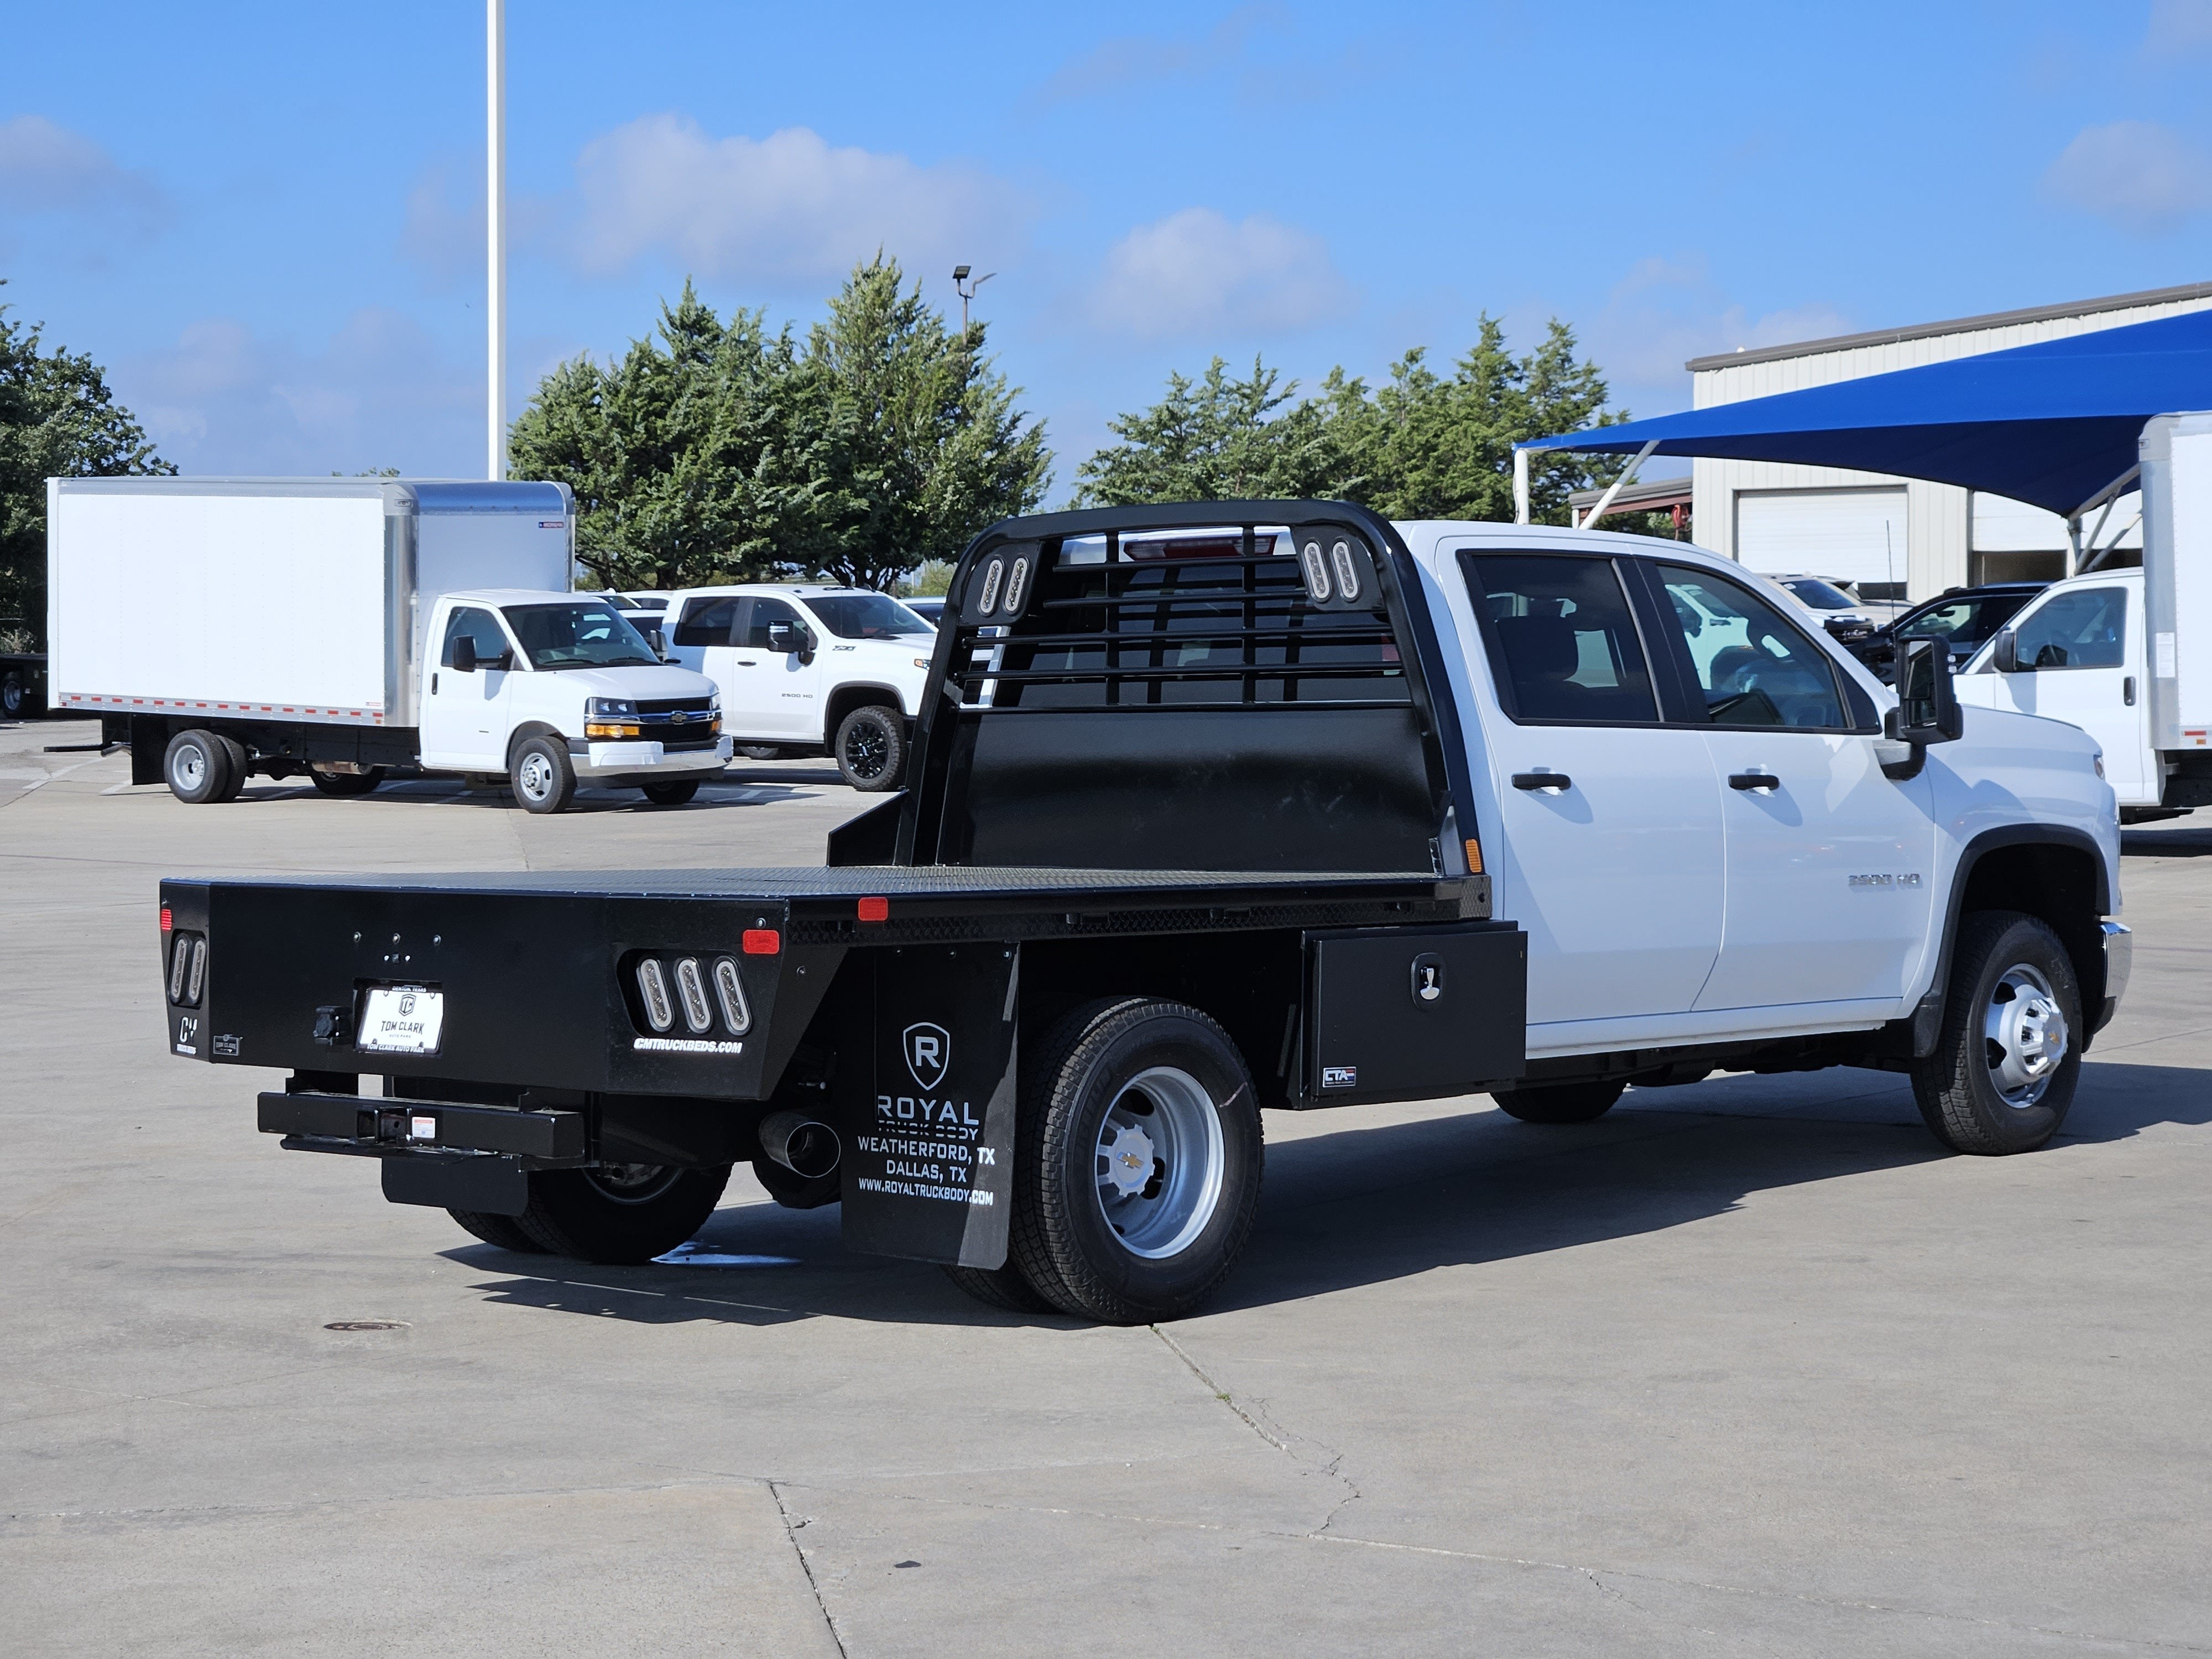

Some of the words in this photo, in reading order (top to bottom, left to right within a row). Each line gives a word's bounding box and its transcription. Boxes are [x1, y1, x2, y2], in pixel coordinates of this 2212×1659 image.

[381, 1021, 398, 1032] TOM
[398, 1022, 425, 1035] CLARK
[634, 1038, 743, 1053] CMTRUCKBEDS.COM
[915, 1036, 941, 1068] R
[1325, 1070, 1348, 1081] CTA
[878, 1095, 979, 1125] ROYAL
[858, 1136, 972, 1165] WEATHERFORD,
[977, 1147, 995, 1165] TX
[886, 1160, 943, 1183] DALLAS,
[950, 1166, 967, 1183] TX
[859, 1177, 994, 1206] WWW.ROYALTRUCKBODY.COM
